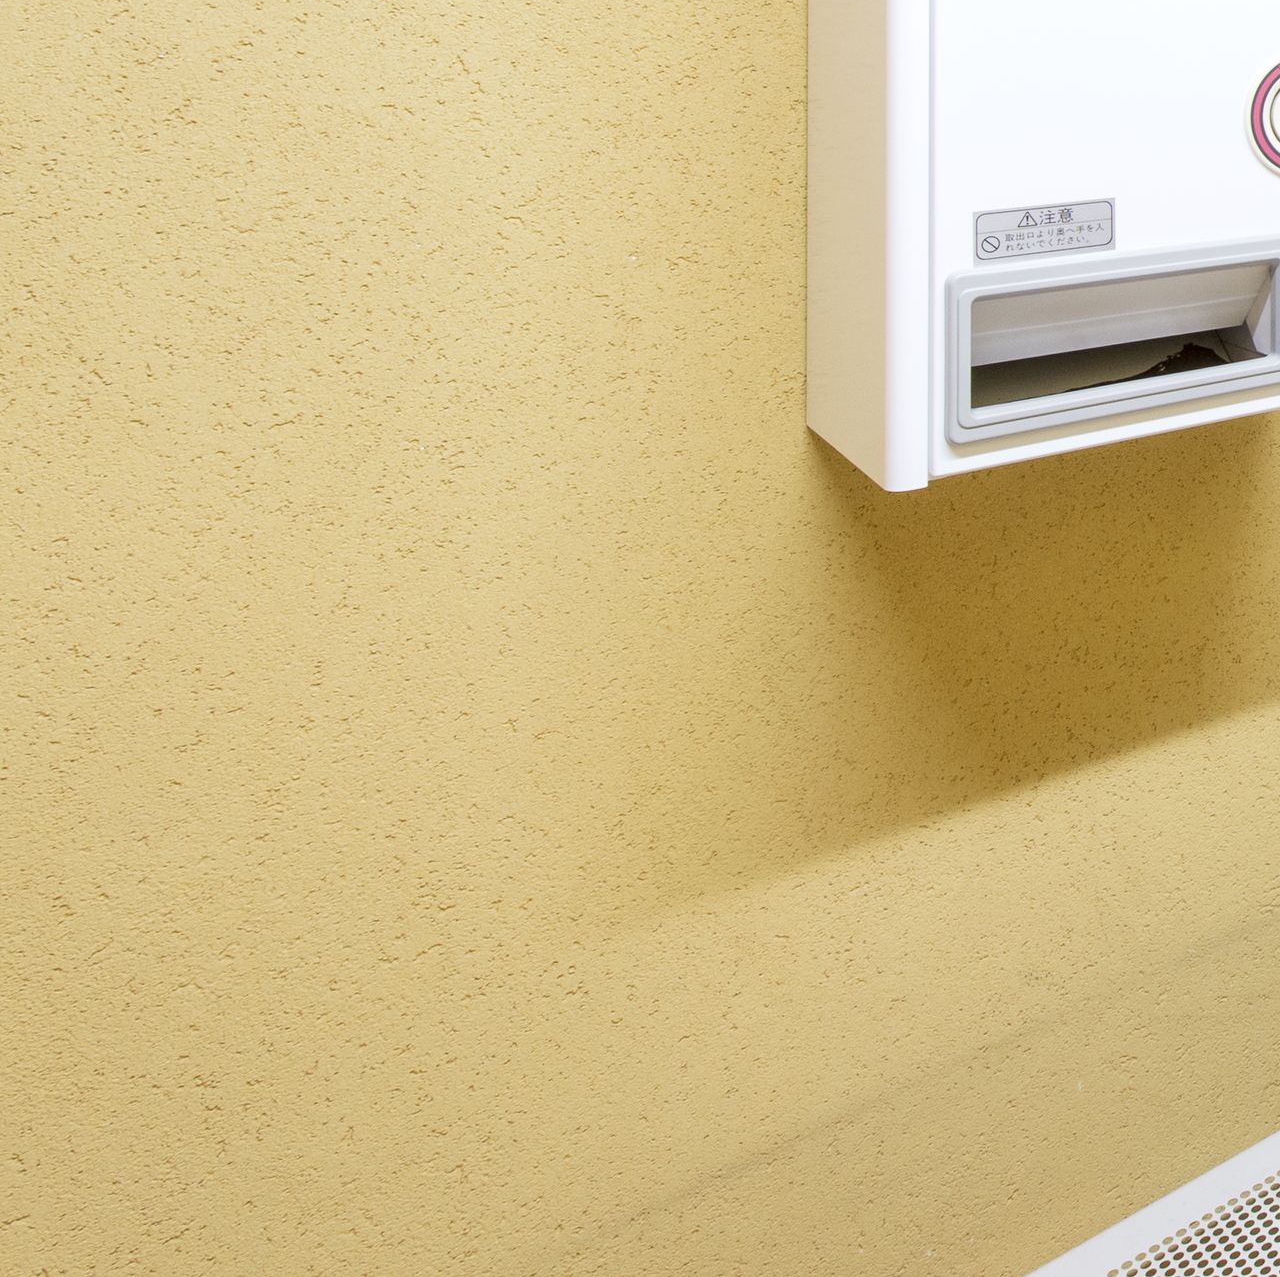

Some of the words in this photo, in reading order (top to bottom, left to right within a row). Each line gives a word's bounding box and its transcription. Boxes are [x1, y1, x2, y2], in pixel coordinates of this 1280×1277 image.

[1039, 208, 1074, 225] 注意
[1005, 223, 1104, 242] 取出口より奥へ手を入
[1005, 236, 1090, 251] れないでください。
